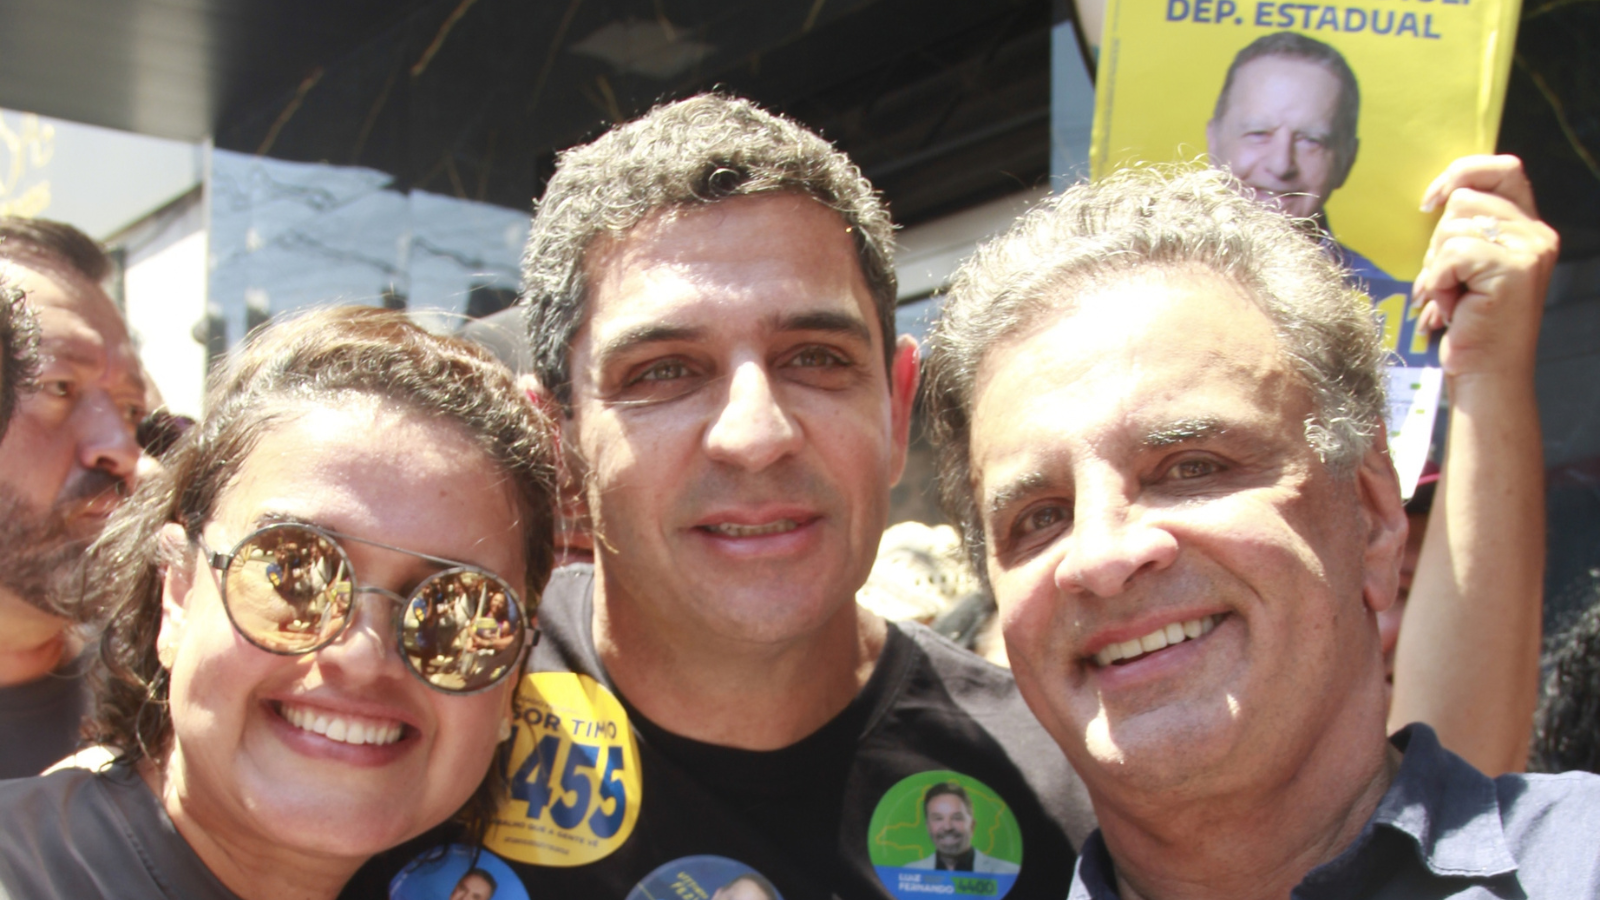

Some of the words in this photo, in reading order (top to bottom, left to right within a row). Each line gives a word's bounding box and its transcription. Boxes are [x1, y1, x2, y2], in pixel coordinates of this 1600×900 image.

[1166, 0, 1243, 25] DEP.
[1254, 2, 1441, 39] ESTADUAL
[557, 830, 585, 844] GENTE
[898, 882, 954, 894] FERNANDO
